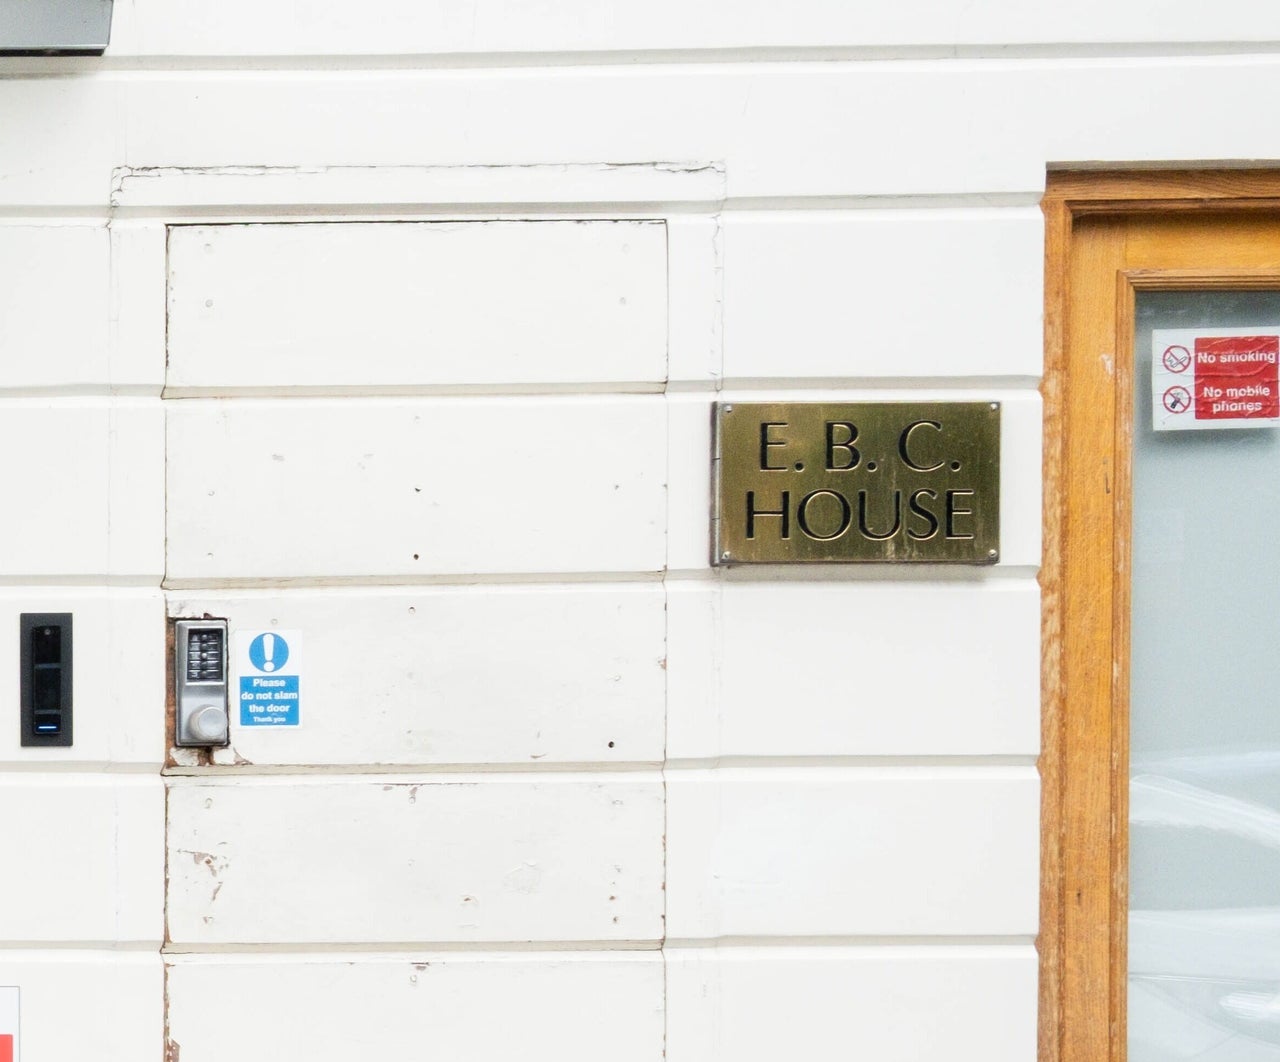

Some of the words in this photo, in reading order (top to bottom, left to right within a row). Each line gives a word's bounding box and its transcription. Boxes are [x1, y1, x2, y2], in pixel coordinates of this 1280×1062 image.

[1197, 353, 1216, 364] No
[1220, 351, 1276, 363] smoking
[1203, 387, 1222, 398] No
[1226, 386, 1270, 397] mobile
[1212, 401, 1262, 414] phones
[745, 489, 974, 541] HOUSE
[253, 679, 285, 687] Please
[241, 692, 254, 700] do
[256, 692, 272, 700] not
[274, 691, 298, 699] slam
[249, 704, 265, 713] the
[267, 704, 290, 712] door
